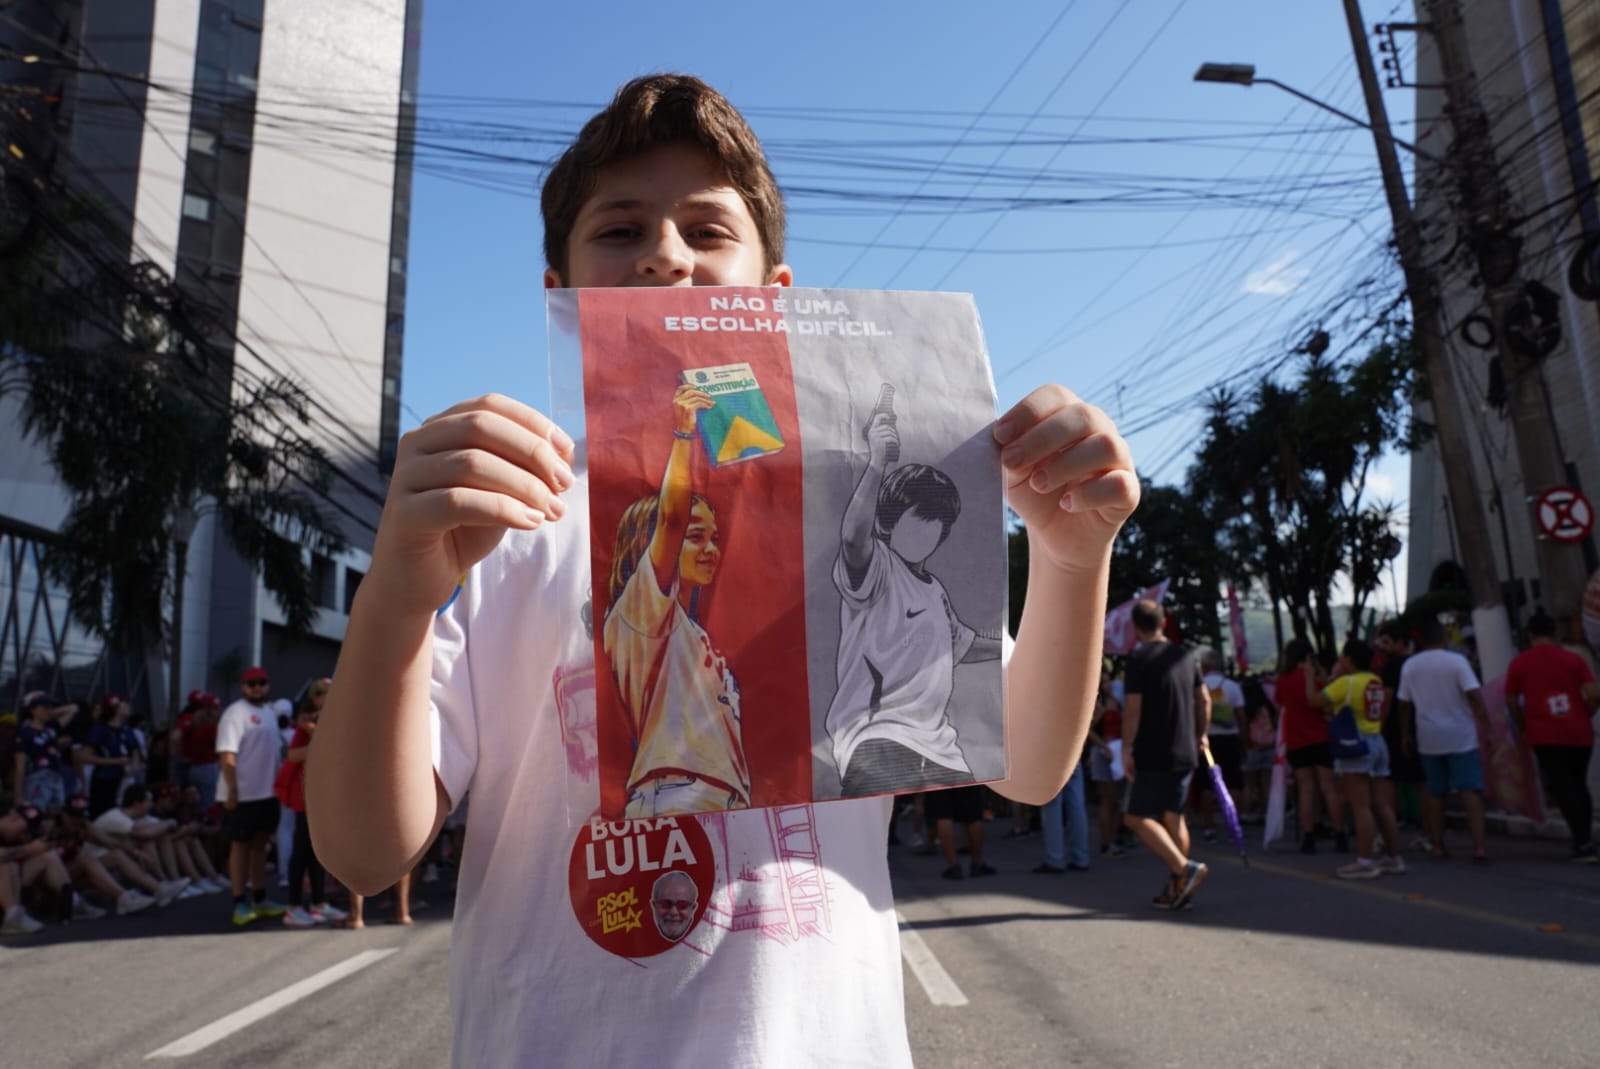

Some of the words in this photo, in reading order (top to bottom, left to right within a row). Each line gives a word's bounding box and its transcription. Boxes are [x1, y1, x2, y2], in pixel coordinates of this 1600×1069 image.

[710, 294, 766, 311] NÃO
[772, 295, 788, 312] É
[794, 299, 850, 315] UMA
[664, 316, 792, 334] ESCOLHA
[796, 318, 894, 337] DIFÍCIL.
[585, 828, 698, 880] LULA
[597, 886, 640, 917] PSOL
